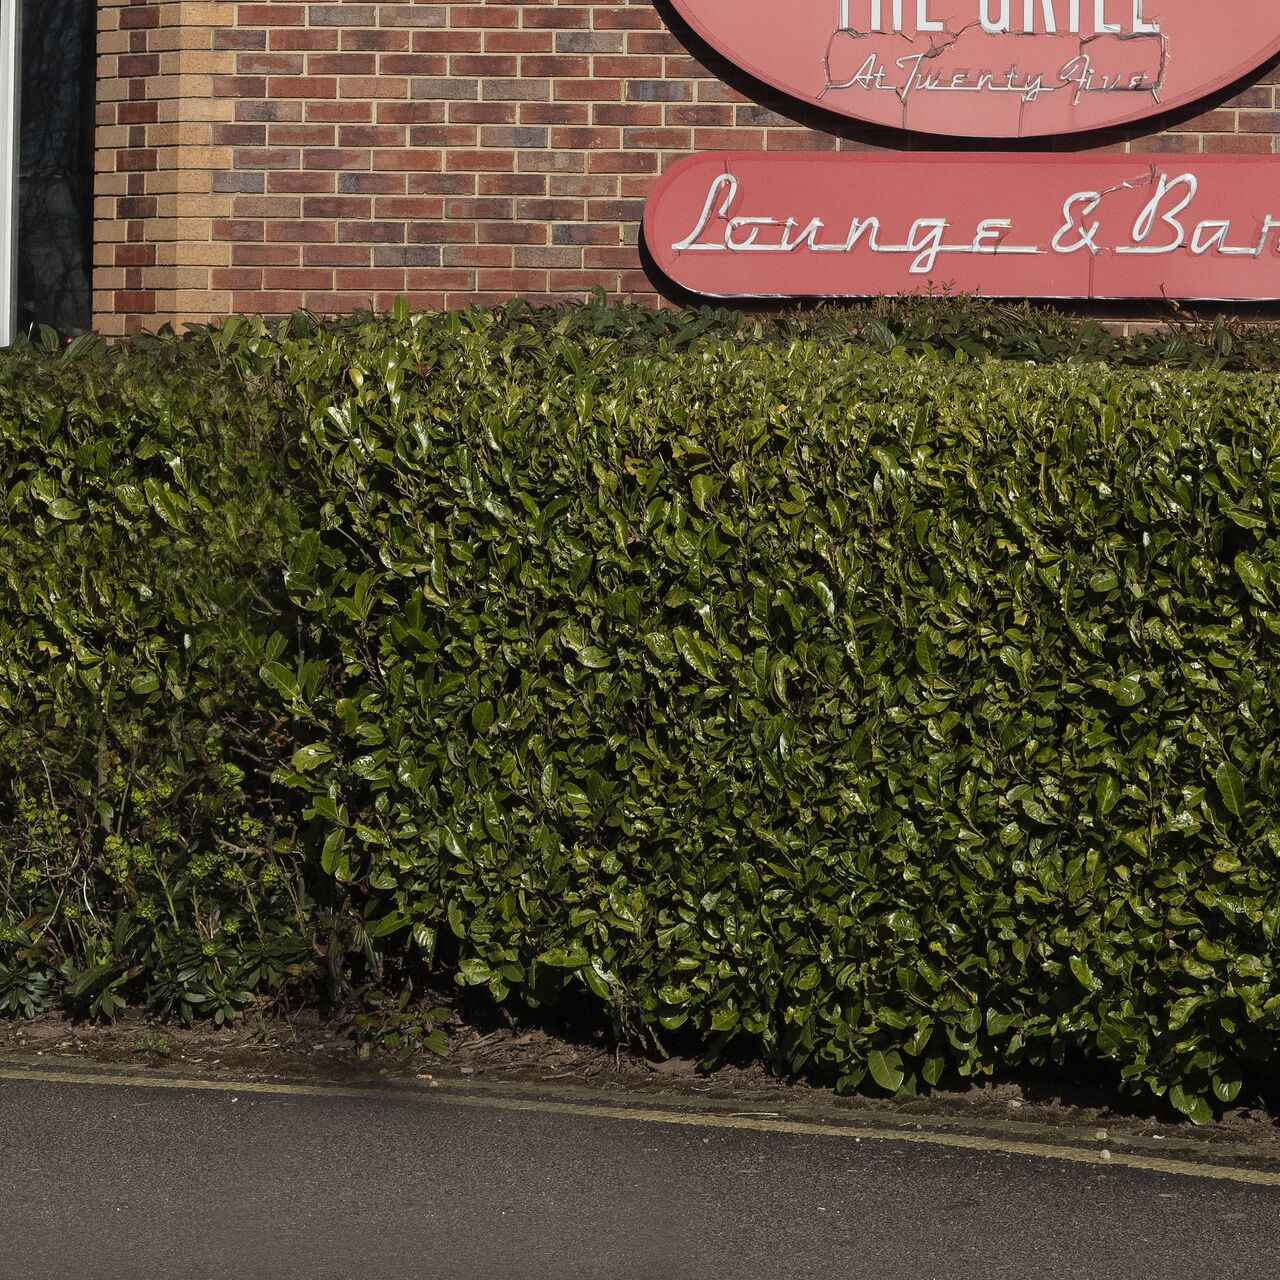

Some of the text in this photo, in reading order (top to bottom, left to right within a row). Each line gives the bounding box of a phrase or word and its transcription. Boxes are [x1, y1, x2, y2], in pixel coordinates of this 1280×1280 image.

[828, 52, 897, 90] At
[895, 52, 1056, 104] Twenty
[671, 172, 1045, 274] Lounge
[1051, 191, 1100, 256] &
